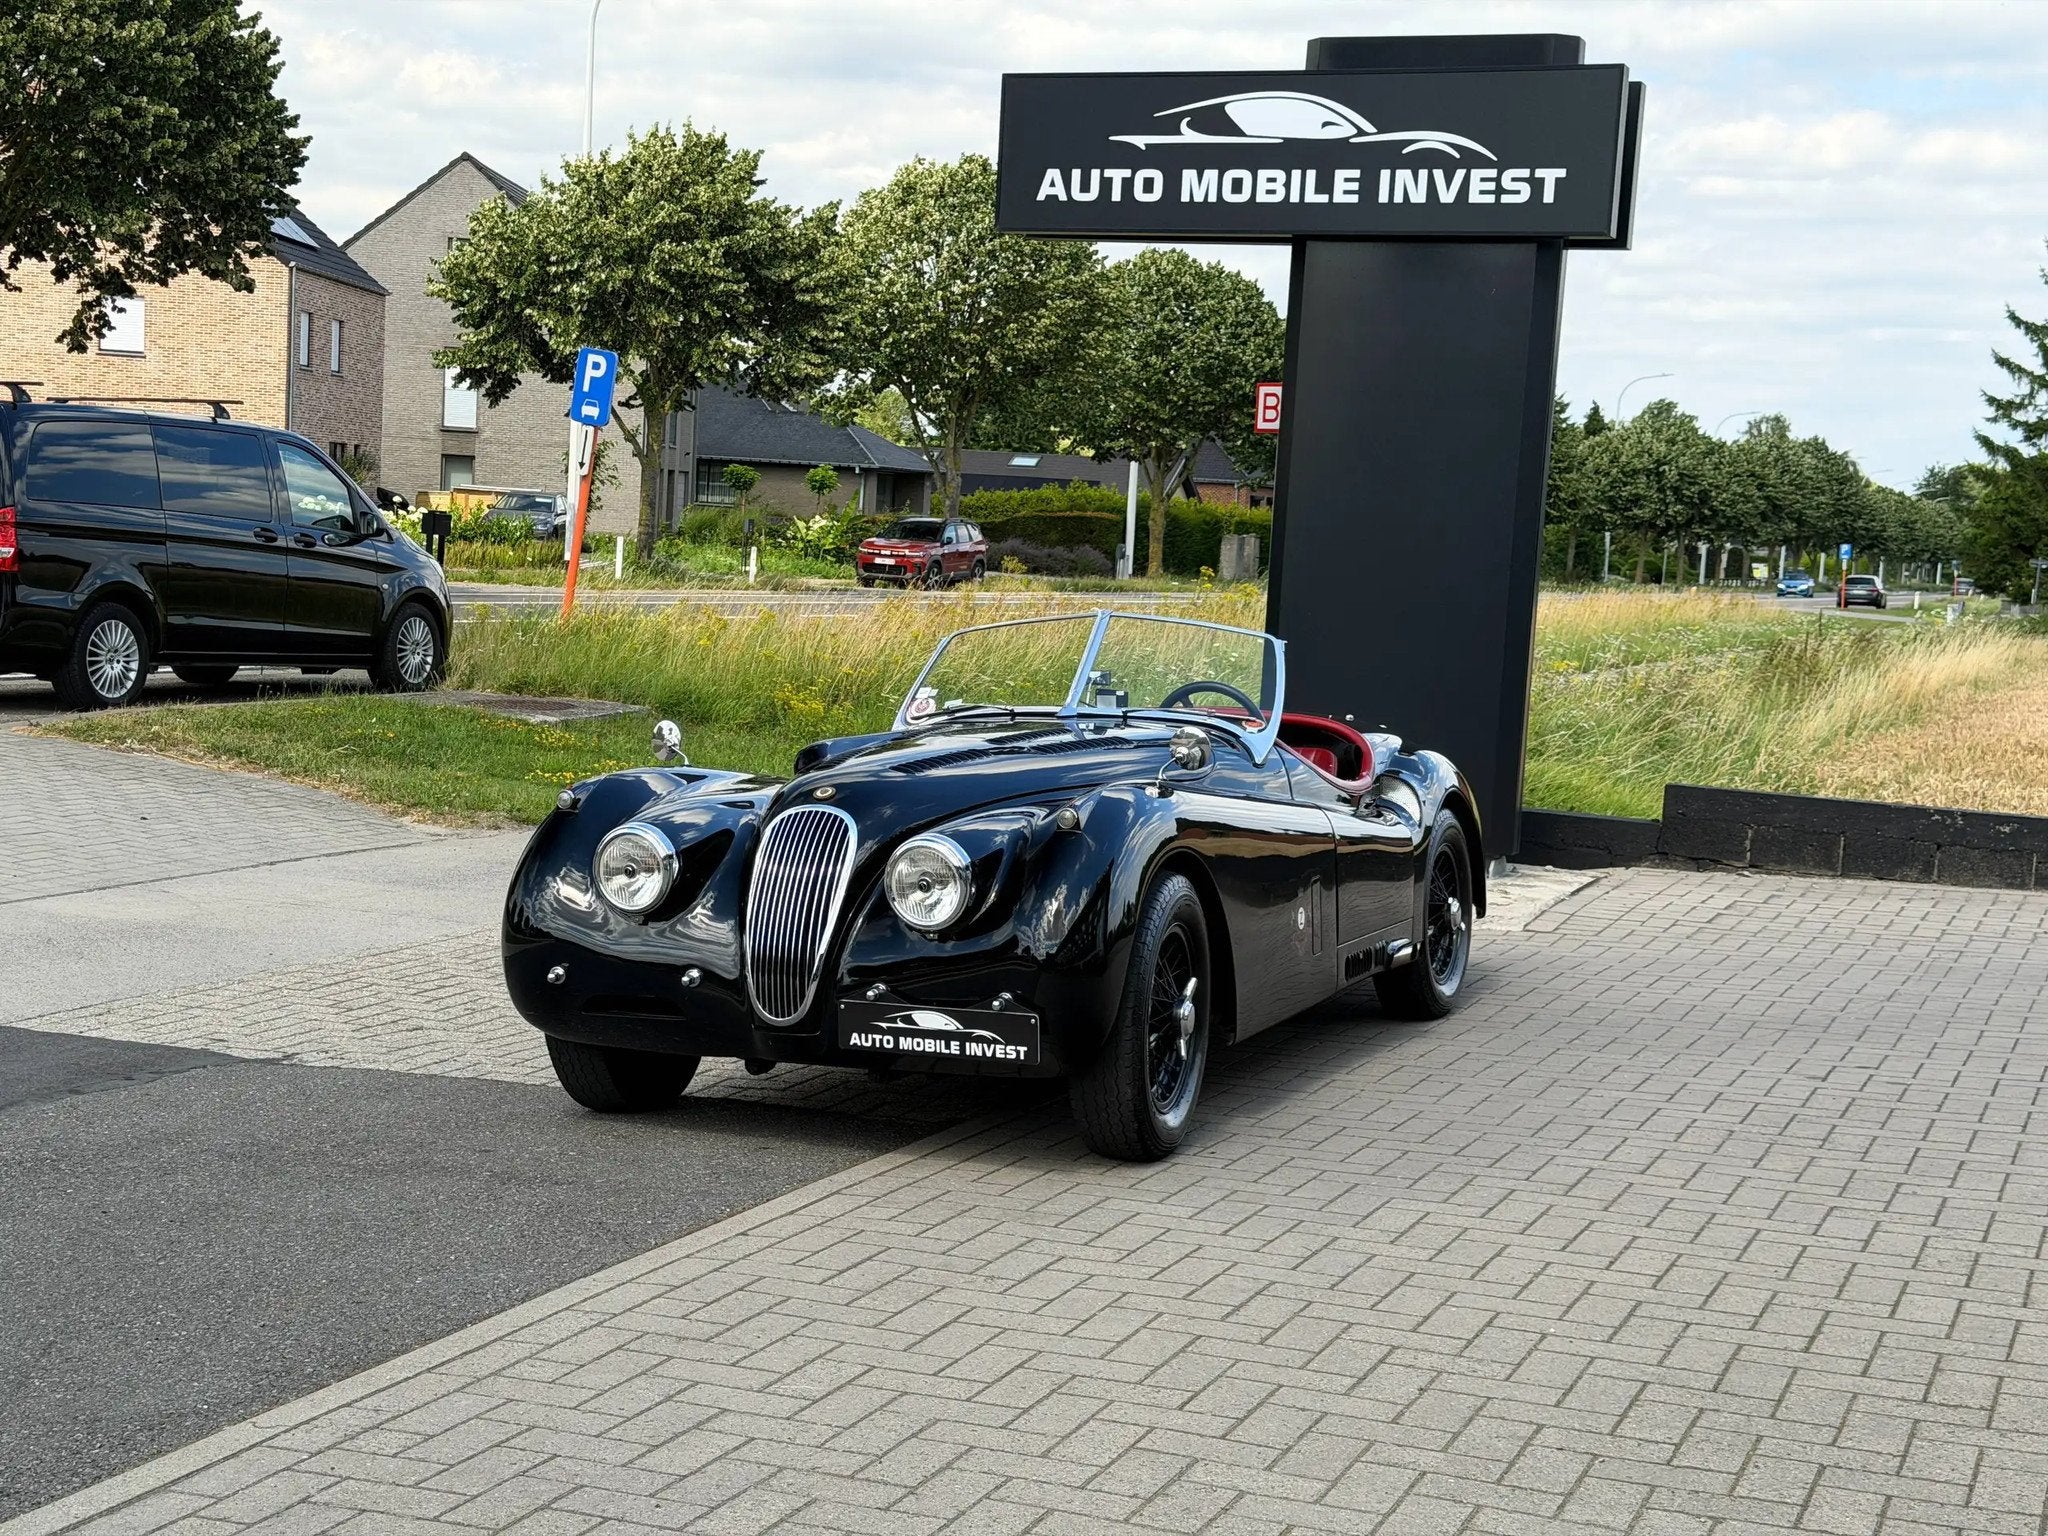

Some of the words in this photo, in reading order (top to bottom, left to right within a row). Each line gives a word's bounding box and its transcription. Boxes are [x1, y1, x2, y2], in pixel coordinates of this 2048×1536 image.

[1036, 168, 1164, 203] AUTO
[1180, 168, 1361, 204] MOBILE
[1377, 167, 1567, 204] INVEST
[582, 353, 608, 393] P
[1262, 392, 1281, 423] B
[850, 1032, 894, 1049] AUTO
[898, 1036, 961, 1055] MOBILE
[965, 1041, 1028, 1060] INVEST
